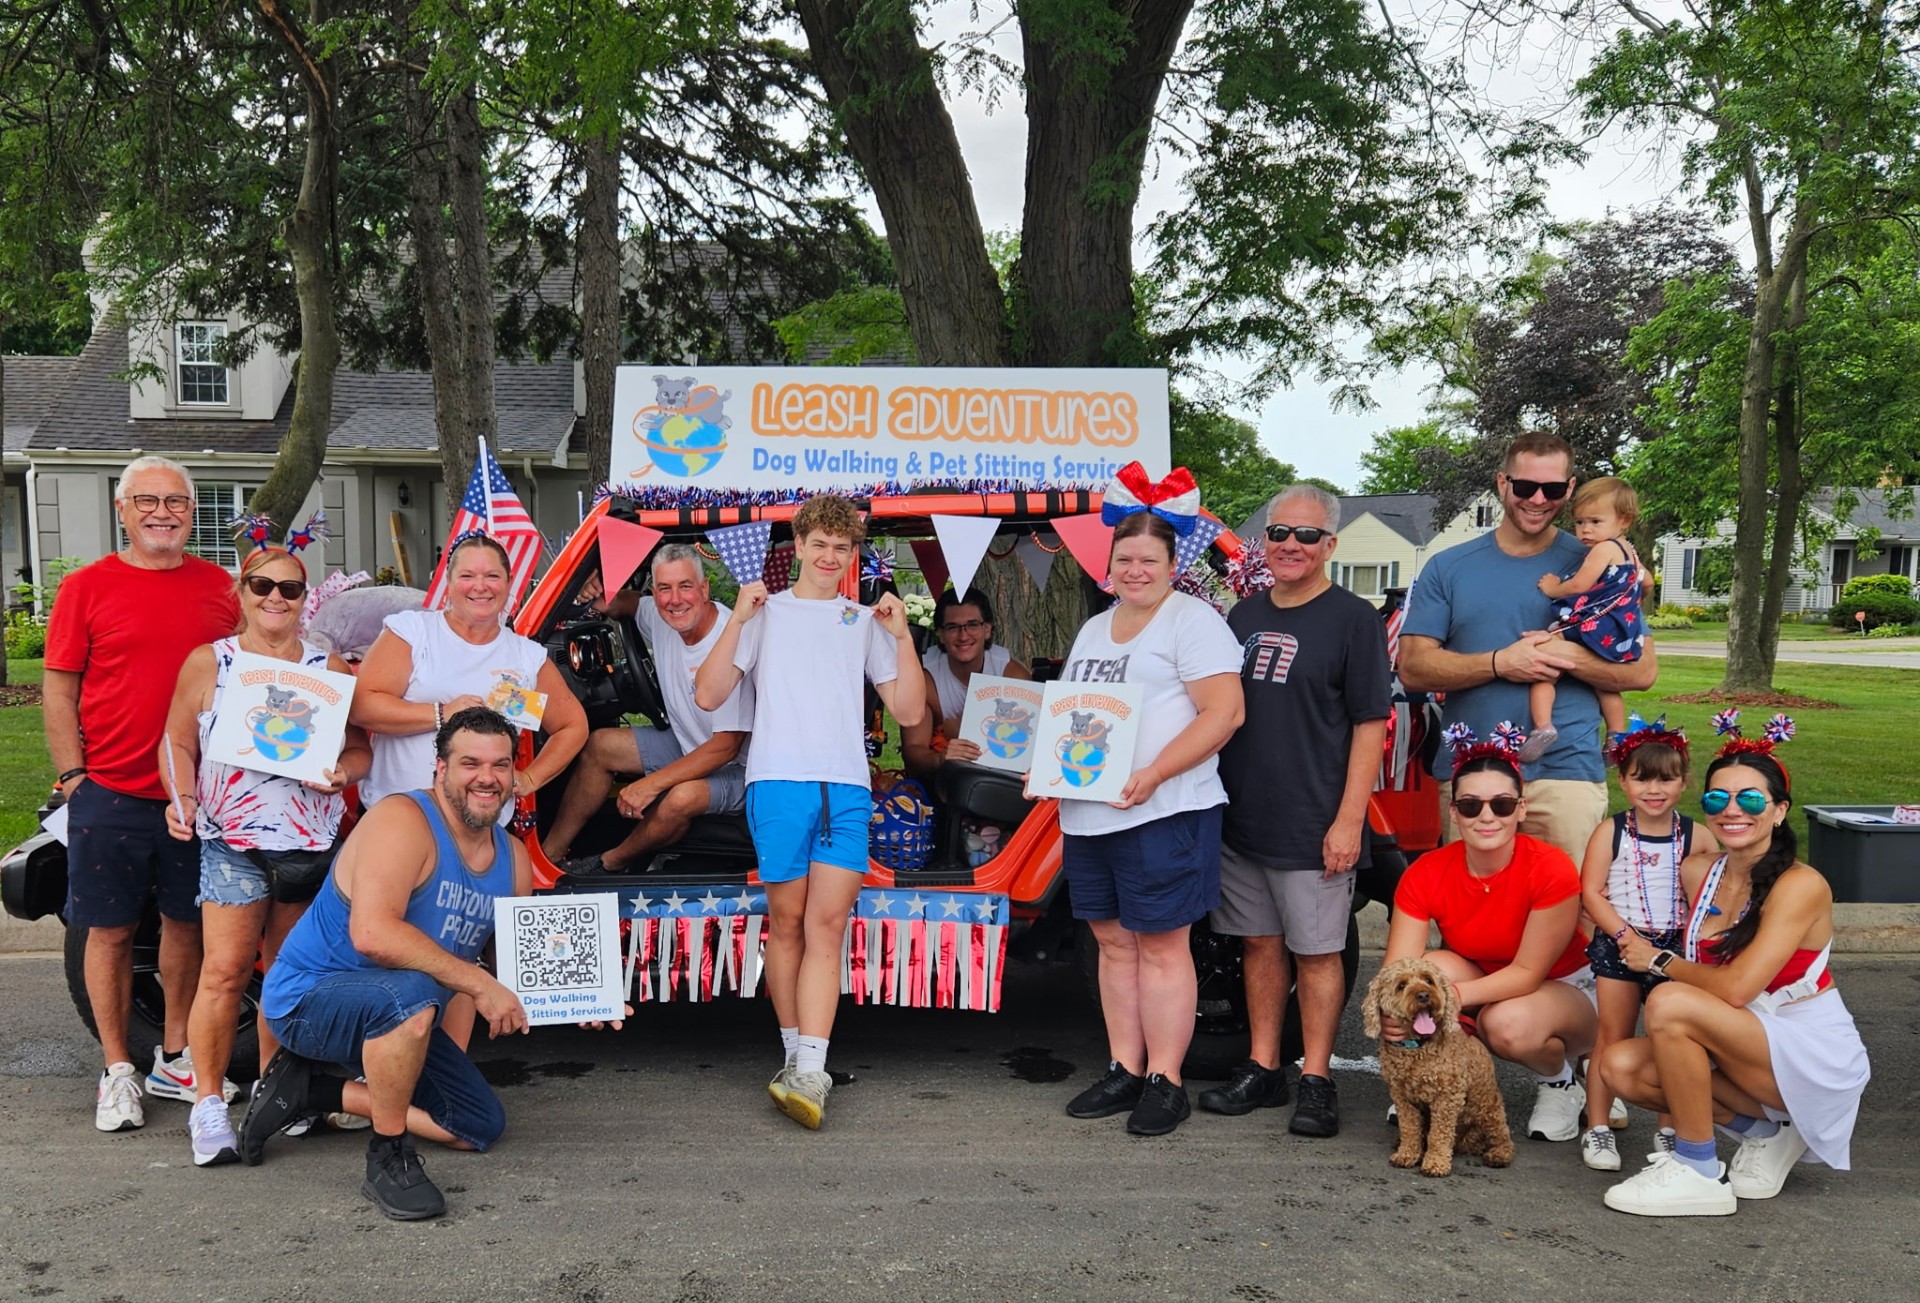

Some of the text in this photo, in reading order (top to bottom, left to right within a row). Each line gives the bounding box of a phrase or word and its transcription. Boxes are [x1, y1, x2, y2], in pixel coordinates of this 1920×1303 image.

[753, 448, 1126, 481] Dog Walking & Pet Sitting Servic
[436, 880, 497, 920] CHITOW
[523, 993, 597, 1005] Dog Walking
[532, 1009, 567, 1018] Sitting
[570, 1007, 612, 1016] Services
